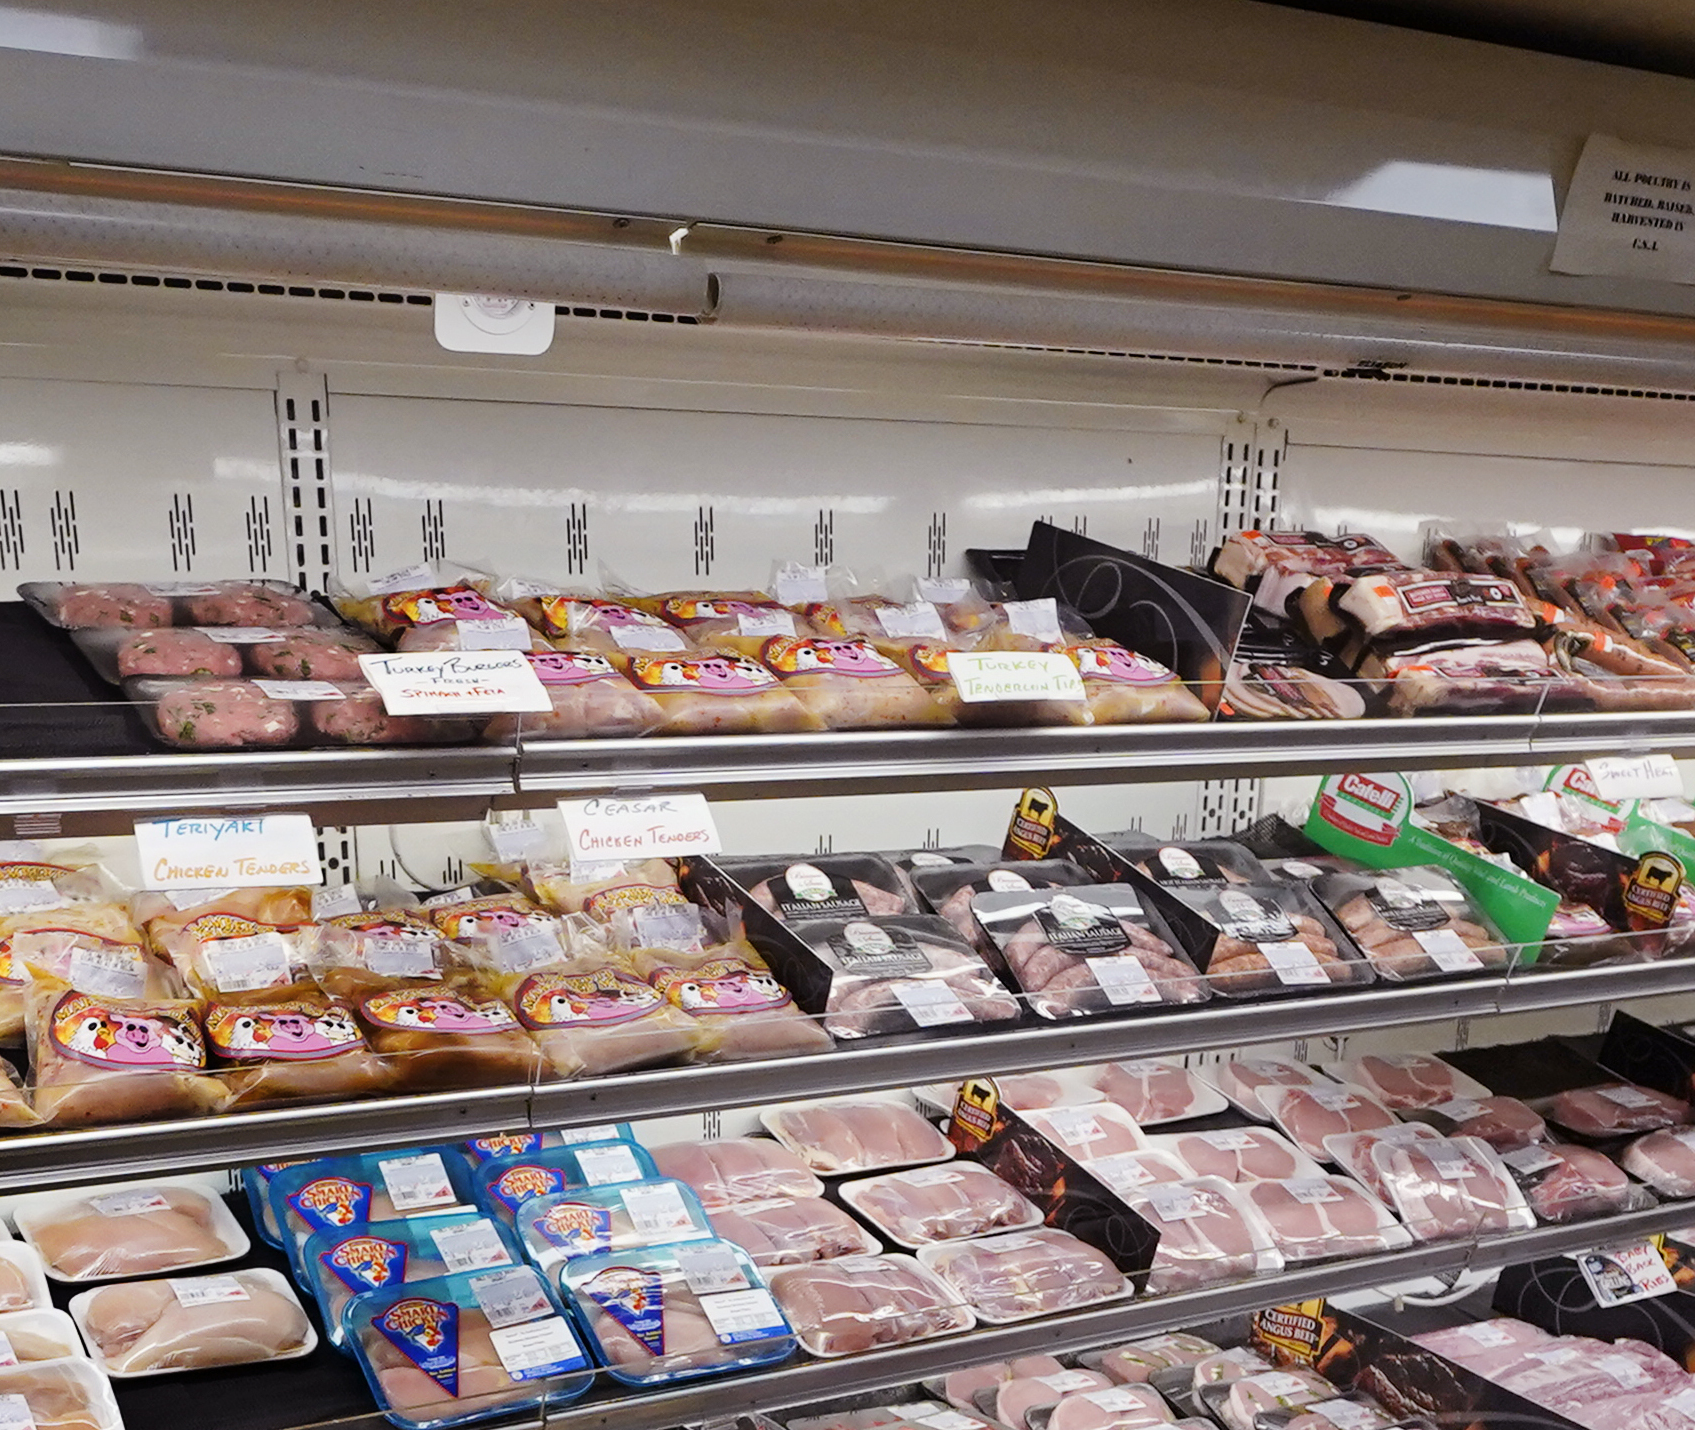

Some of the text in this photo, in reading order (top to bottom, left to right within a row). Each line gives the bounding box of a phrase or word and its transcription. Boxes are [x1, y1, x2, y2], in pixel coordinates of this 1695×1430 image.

[967, 657, 1049, 671] TURKEY
[584, 798, 677, 816] CEASAR
[152, 818, 266, 841] TERIYAKI
[579, 825, 710, 850] CHICKEN TENDERS
[154, 857, 311, 881] CHICKEN TENDERS
[500, 1176, 557, 1196] CHICKEN
[505, 1172, 544, 1184] SMART
[300, 1189, 362, 1209] CHICKEN
[306, 1184, 352, 1200] SMART
[333, 1247, 398, 1268] CHICKEN
[339, 1243, 387, 1258] SMART
[384, 1310, 449, 1333] CHICKEN
[391, 1304, 438, 1320] SMART
[1265, 1308, 1316, 1331] CERTIFIED
[1259, 1318, 1316, 1344] ANGUS BEEF
